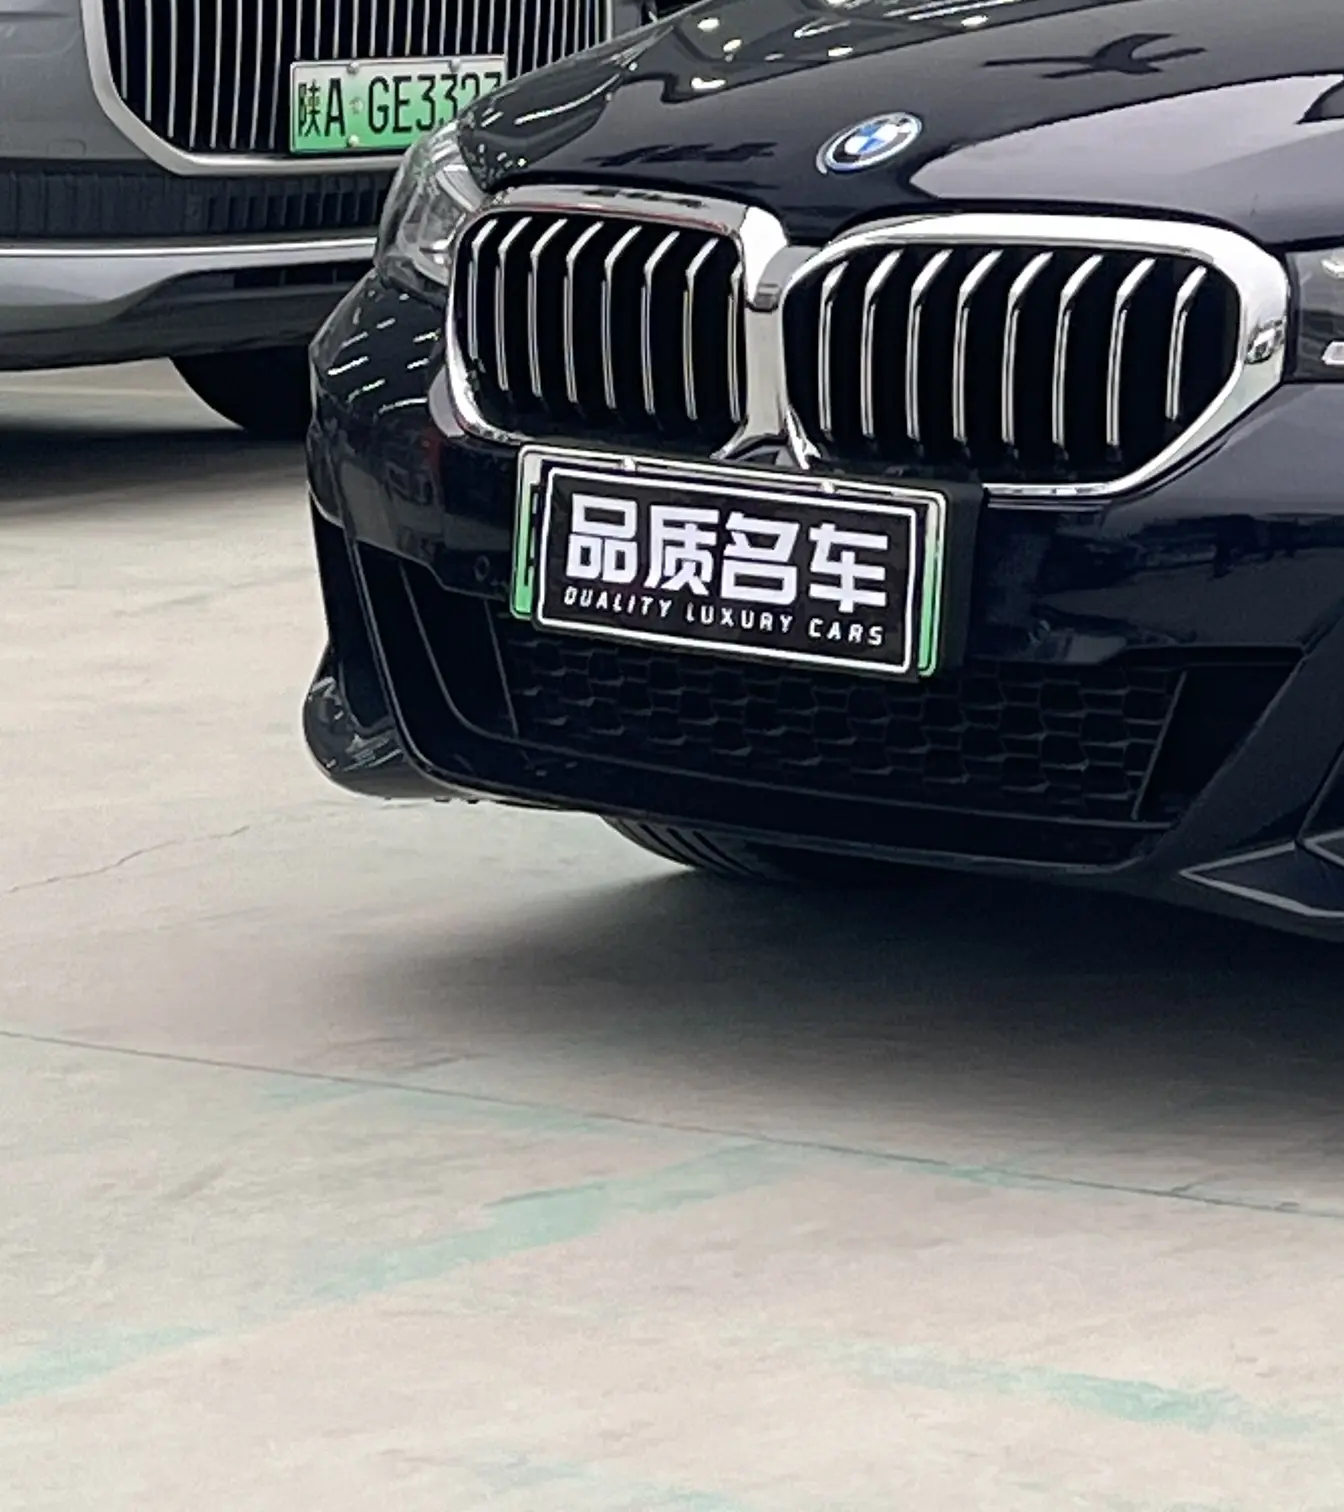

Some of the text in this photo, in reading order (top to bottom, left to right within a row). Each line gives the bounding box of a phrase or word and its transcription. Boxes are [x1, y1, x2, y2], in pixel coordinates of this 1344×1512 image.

[564, 493, 889, 614] 品质名车
[563, 585, 885, 647] QUALITY LUXURY CARS
